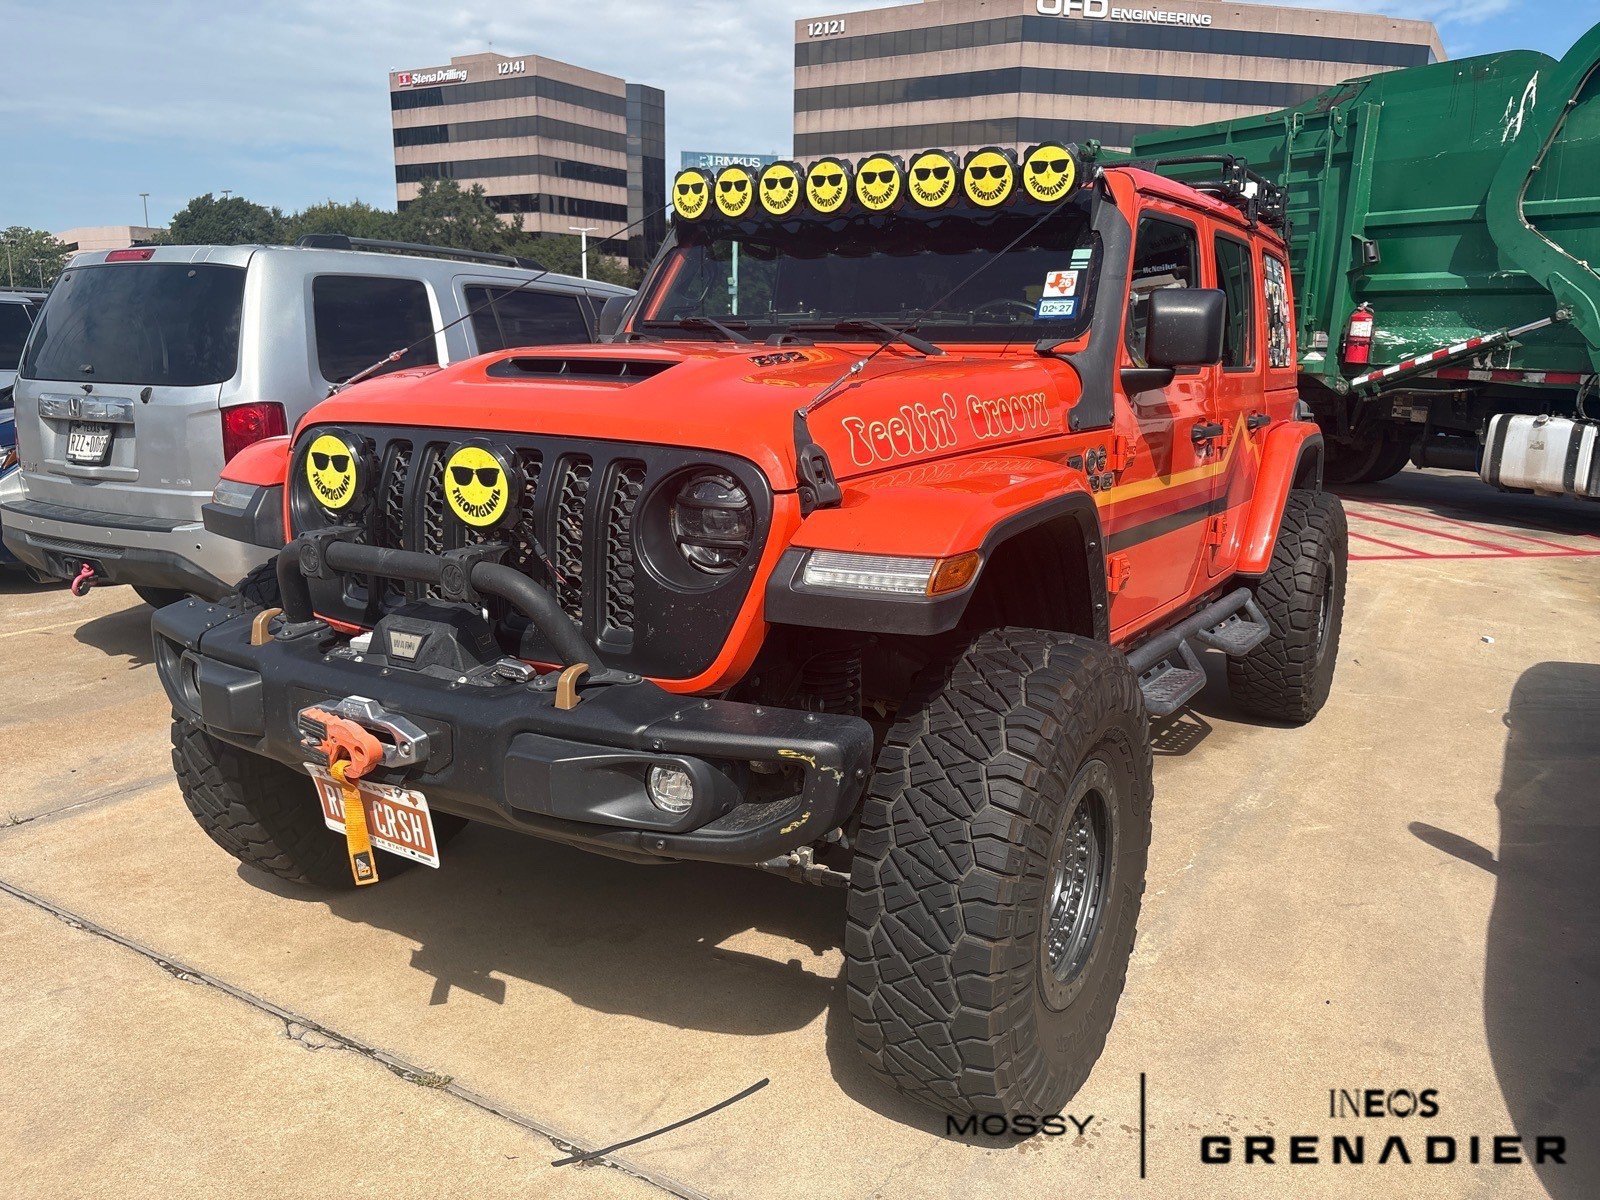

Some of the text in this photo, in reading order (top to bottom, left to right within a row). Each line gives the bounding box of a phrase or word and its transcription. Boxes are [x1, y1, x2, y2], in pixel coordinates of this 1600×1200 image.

[1111, 8, 1212, 25] ENGINEERING
[807, 19, 846, 37] 12121
[412, 71, 437, 85] Stena
[437, 68, 468, 82] Drilling
[497, 60, 526, 76] 12141
[1142, 262, 1178, 274] McNeilus
[1059, 278, 1071, 288] 26
[83, 424, 100, 433] TEXAS
[841, 392, 1050, 467] Feelin' Groovy
[373, 800, 428, 849] CRSH
